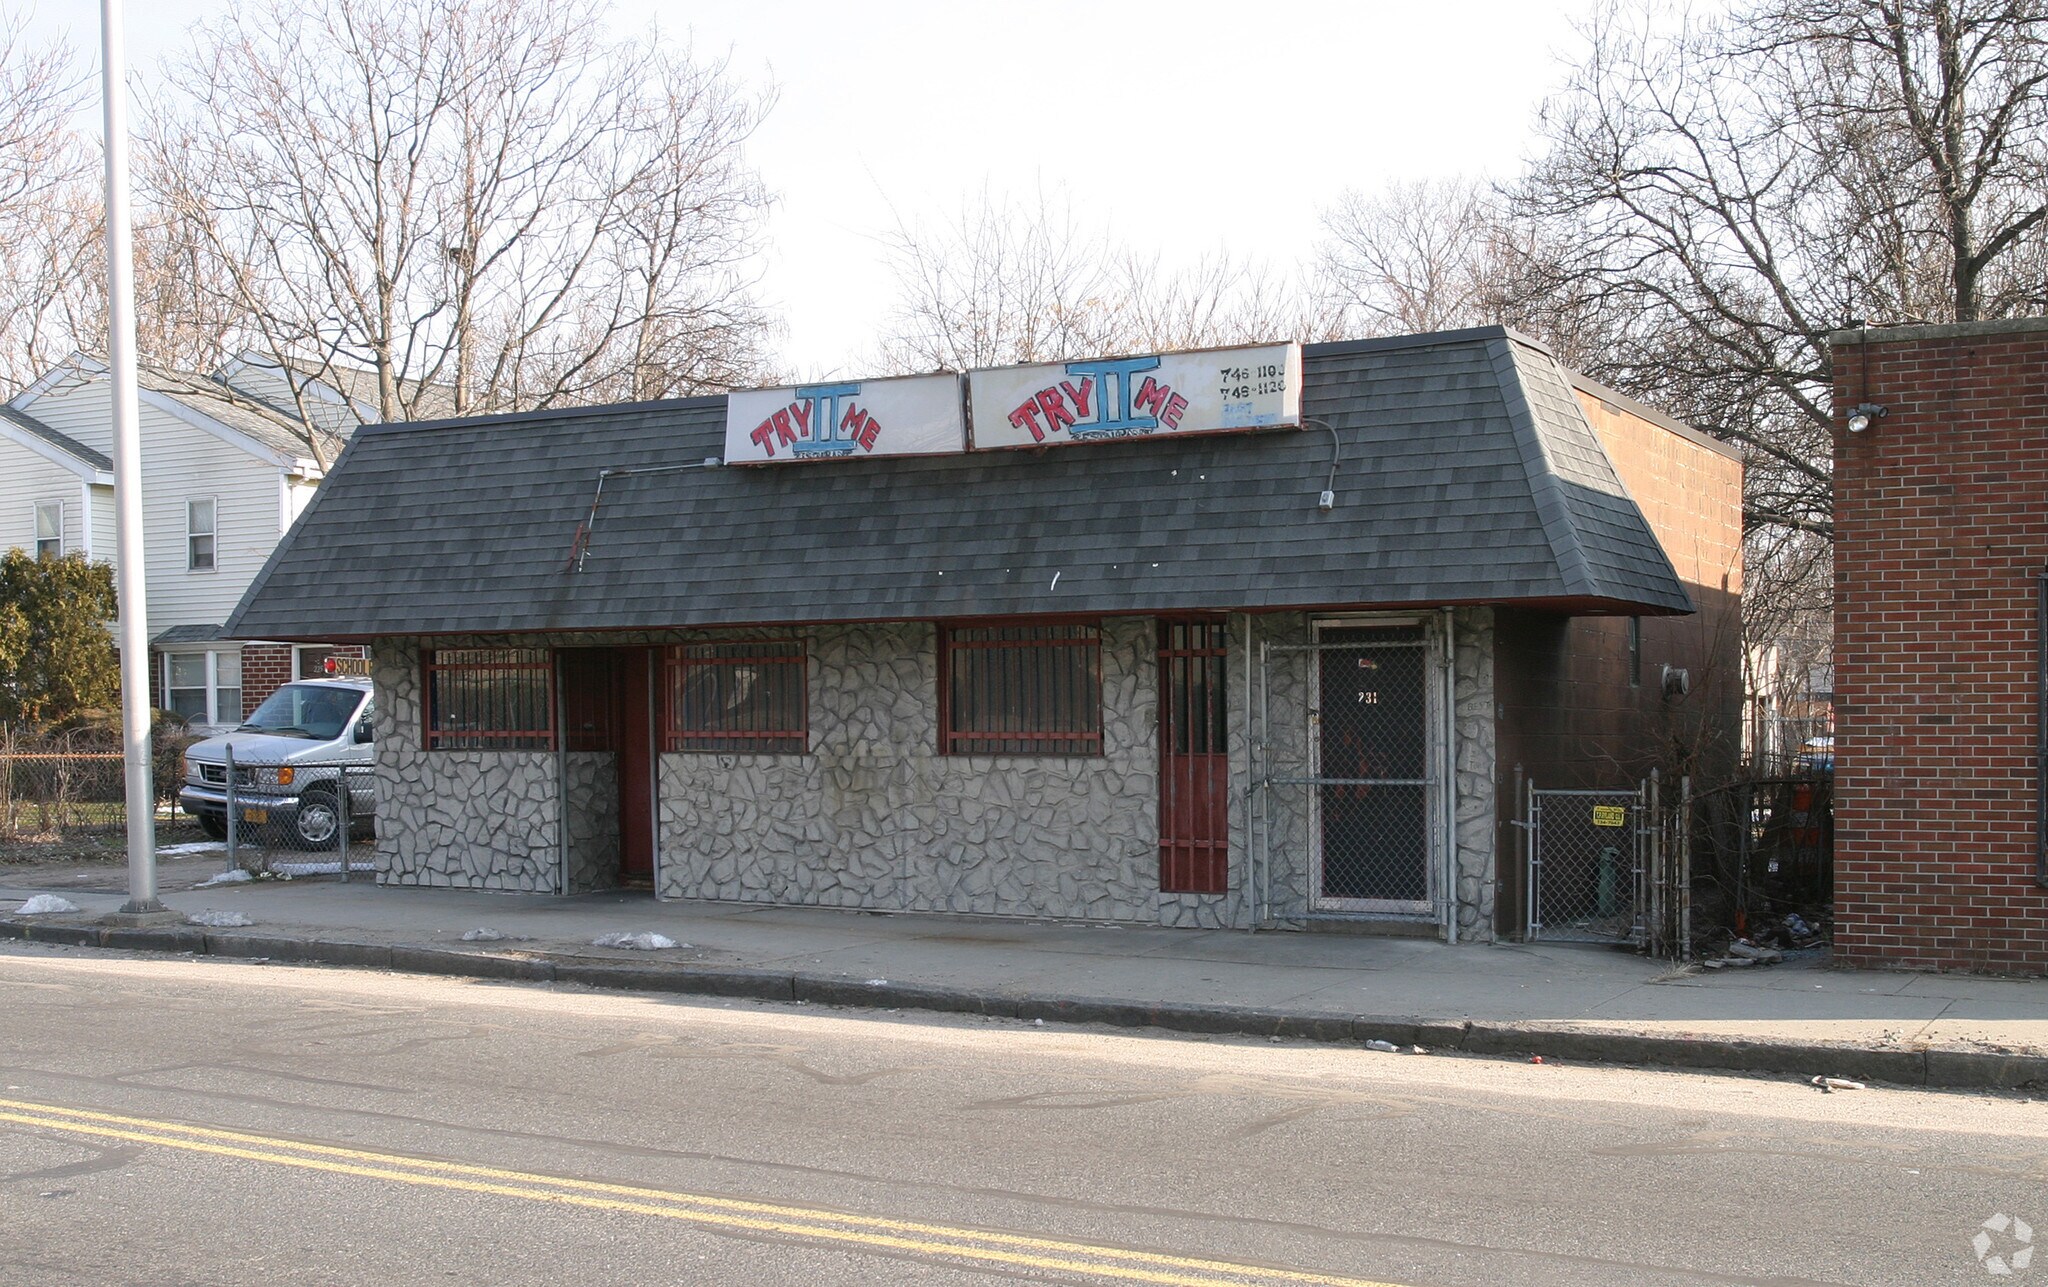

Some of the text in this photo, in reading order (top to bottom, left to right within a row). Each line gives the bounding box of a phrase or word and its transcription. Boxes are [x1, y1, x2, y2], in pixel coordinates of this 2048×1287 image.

[750, 398, 812, 457] TRY
[840, 402, 882, 453] ME
[1007, 377, 1092, 442] TRY
[1134, 376, 1188, 430] ME
[336, 658, 367, 675] SCHOOL
